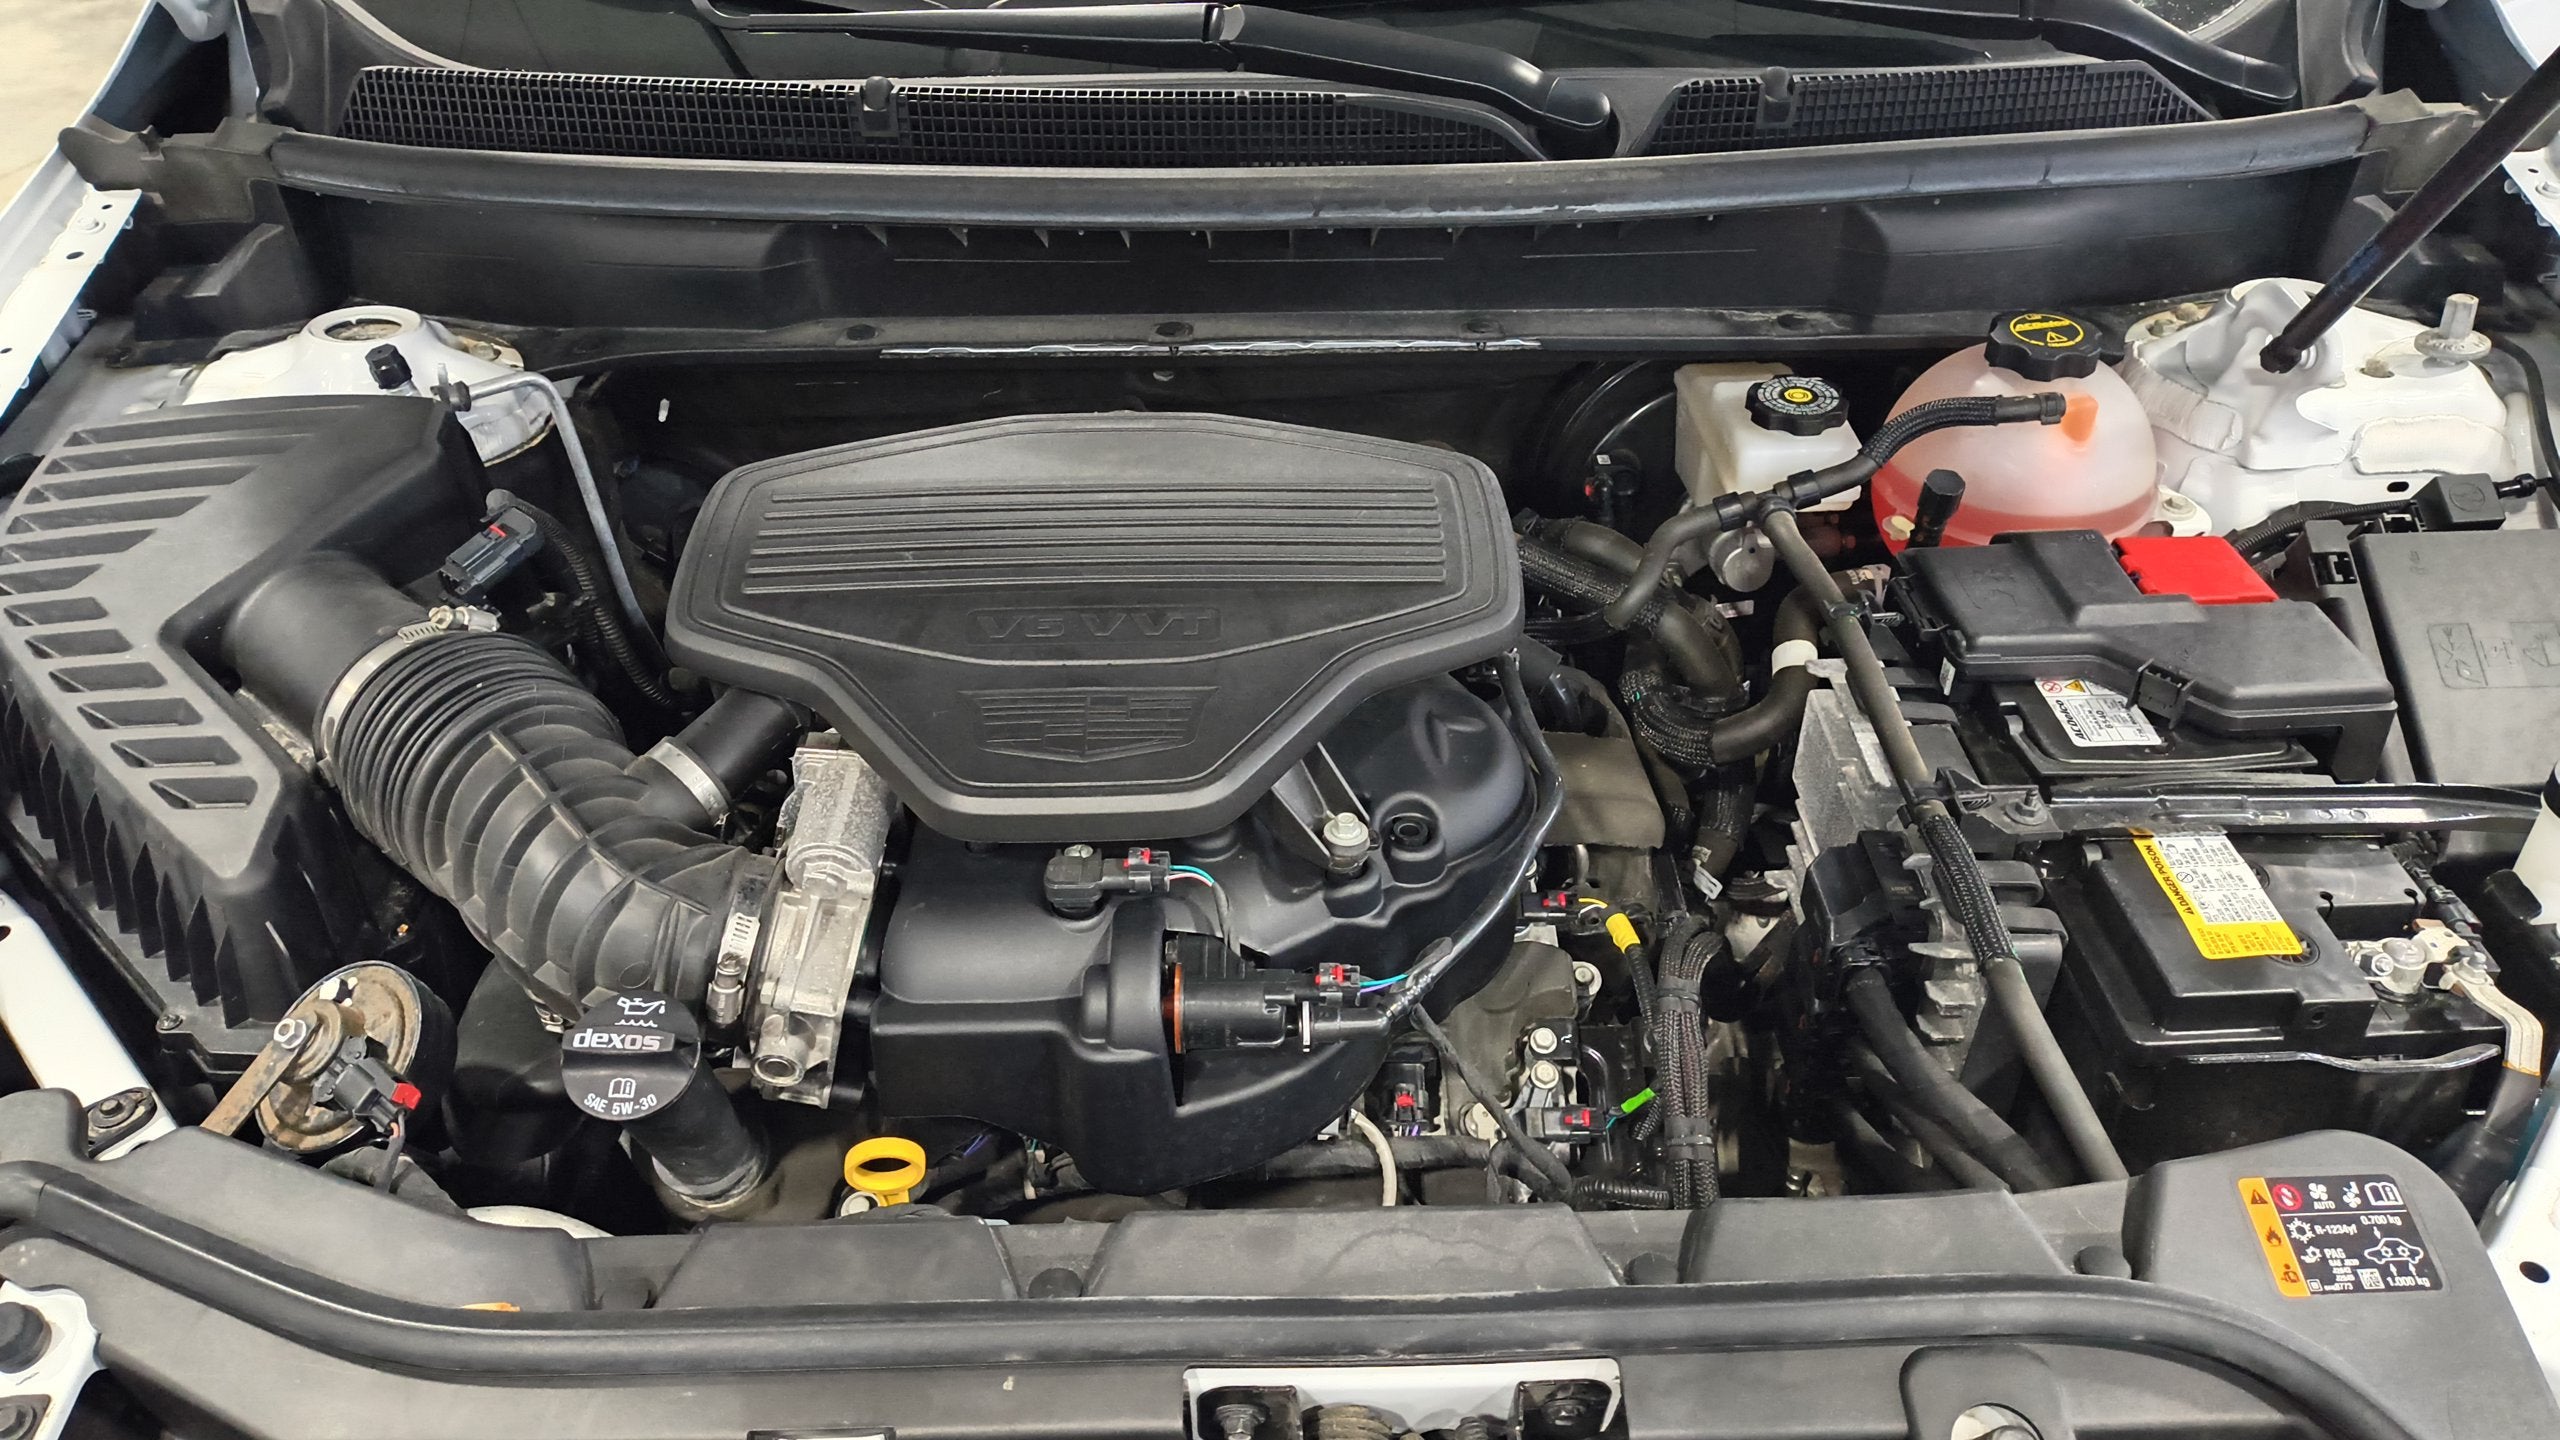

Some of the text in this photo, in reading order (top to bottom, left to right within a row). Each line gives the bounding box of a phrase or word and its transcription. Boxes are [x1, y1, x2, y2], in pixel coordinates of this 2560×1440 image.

[1080, 612, 1210, 638] VVT
[2055, 699, 2087, 740] ACDelco
[2144, 844, 2190, 908] DANGER POISON
[572, 1028, 665, 1050] dexos
[584, 1093, 658, 1115] SAE 5W-30
[2313, 1200, 2336, 1210] AUTO
[2360, 1214, 2403, 1226] 0.700 kg
[2314, 1223, 2358, 1236] R-1234yf
[2323, 1247, 2346, 1259] PAG
[2386, 1275, 2431, 1288] 1.000 kg
